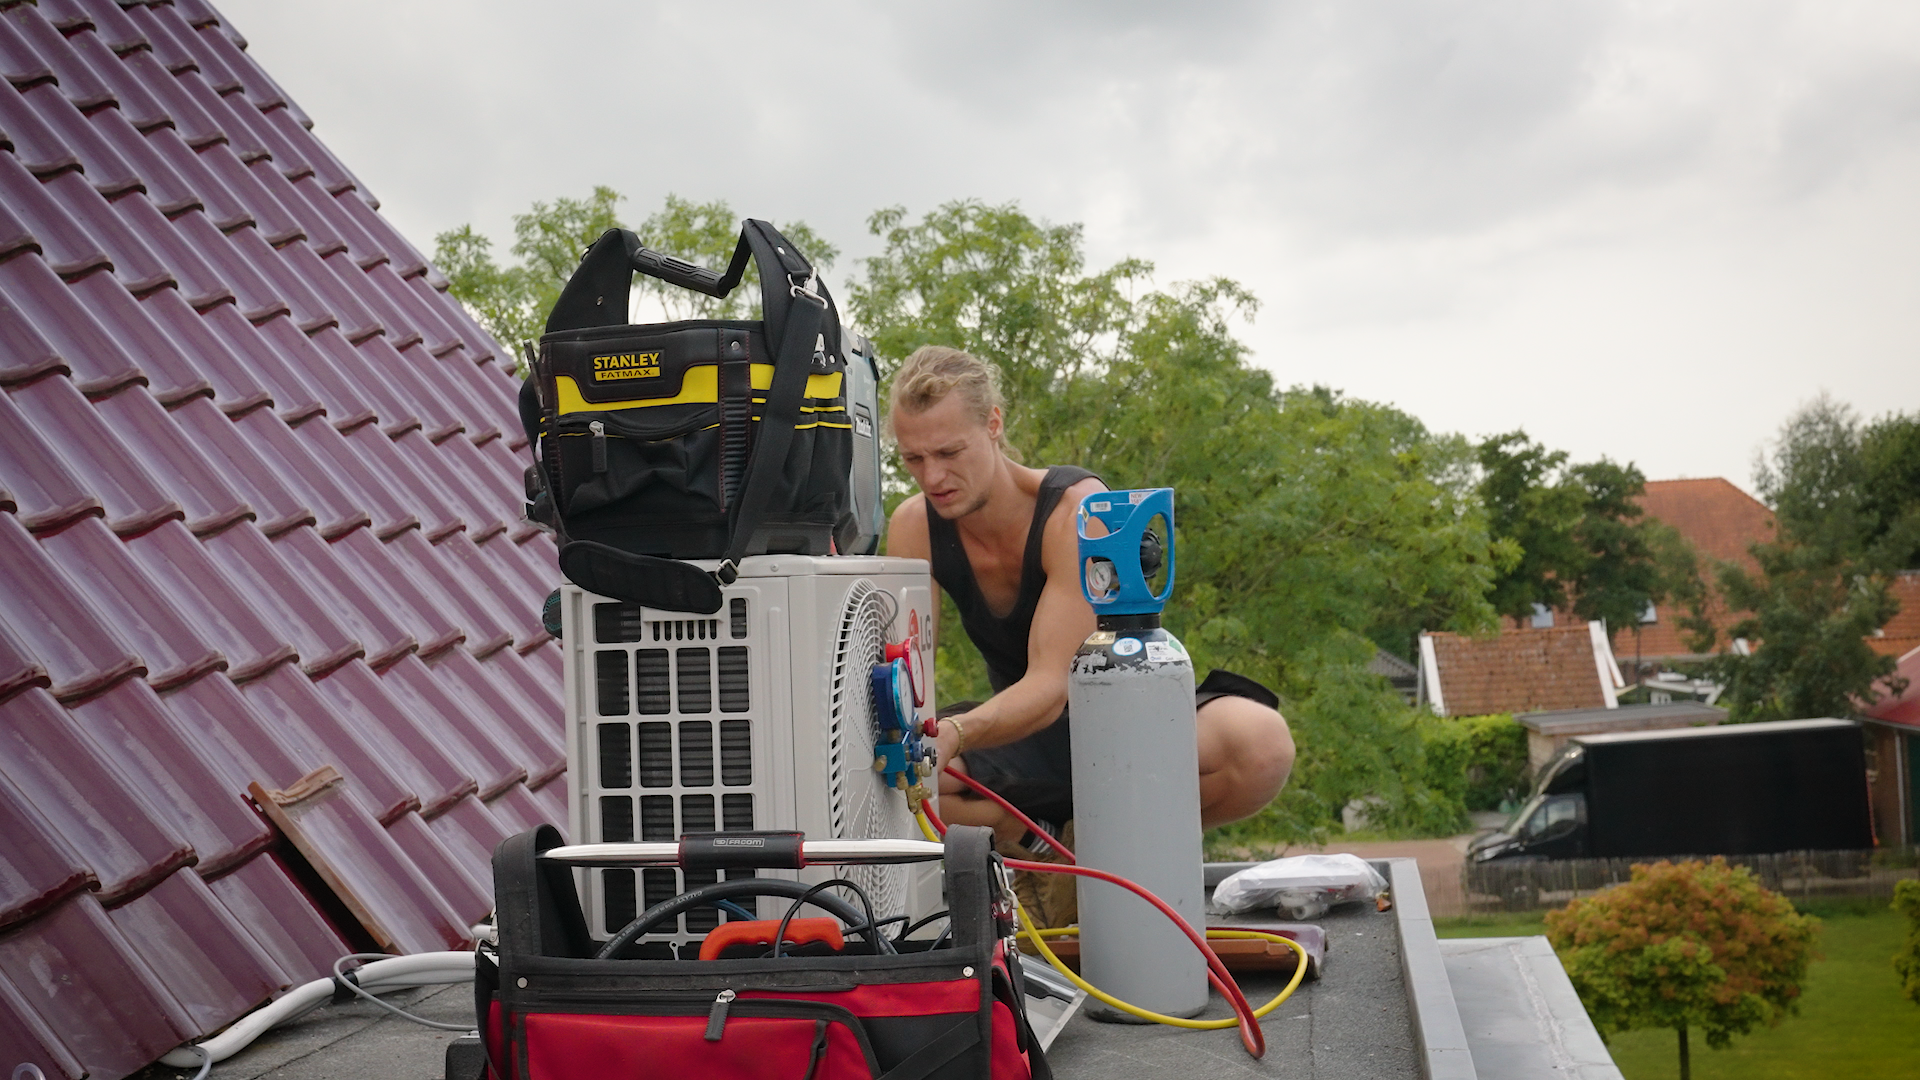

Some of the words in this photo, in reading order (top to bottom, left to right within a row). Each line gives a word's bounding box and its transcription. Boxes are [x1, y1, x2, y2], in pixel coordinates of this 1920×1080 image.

[593, 352, 659, 370] STANLEY
[601, 369, 652, 379] FATMAX
[920, 614, 931, 652] LG
